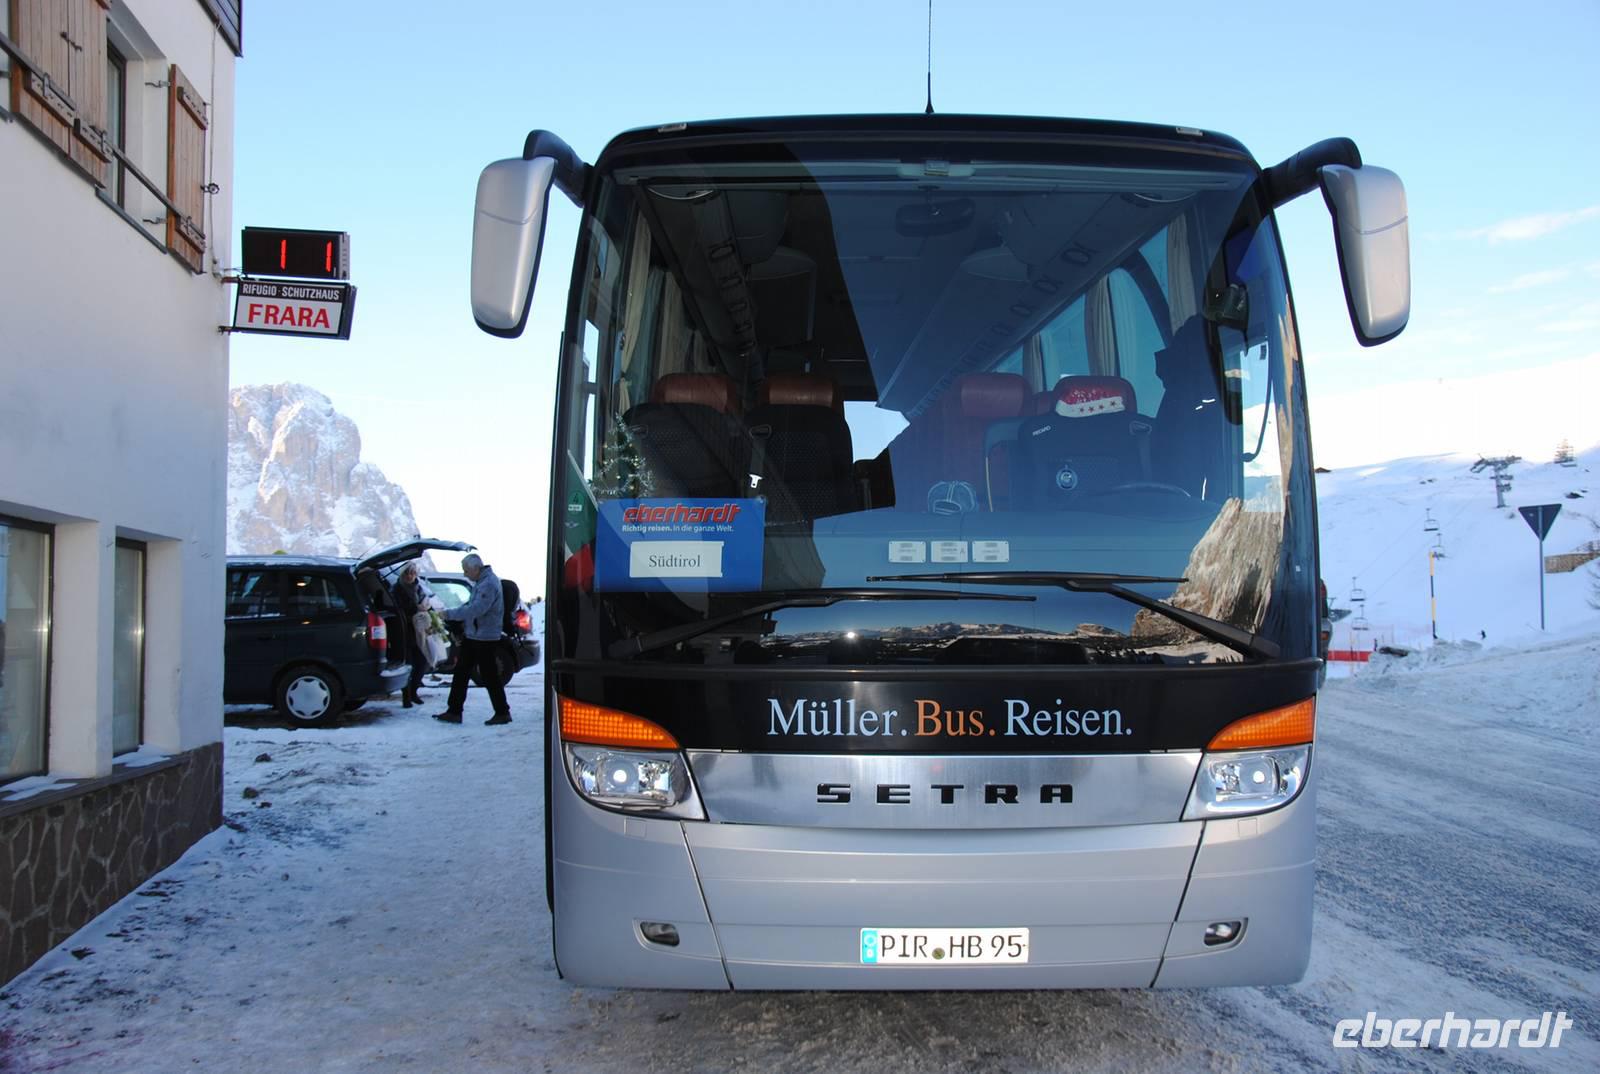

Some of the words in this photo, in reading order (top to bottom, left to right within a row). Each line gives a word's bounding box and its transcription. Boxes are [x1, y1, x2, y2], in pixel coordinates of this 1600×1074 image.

[242, 283, 277, 296] RIFUGIO
[281, 286, 340, 301] SCHUTZHAUS
[247, 302, 331, 329] FRARA
[623, 503, 742, 523] eberhardt
[622, 524, 647, 534] Richtig
[694, 526, 715, 534] ganze
[716, 524, 735, 532] Welt.
[648, 554, 701, 568] Südtirol
[766, 697, 908, 737] Müller.
[913, 698, 996, 737] Bus.
[1003, 698, 1133, 737] Reisen.
[816, 783, 1074, 805] SETRA
[880, 934, 928, 958] PIR
[949, 935, 983, 959] HB
[990, 934, 1023, 958] 95
